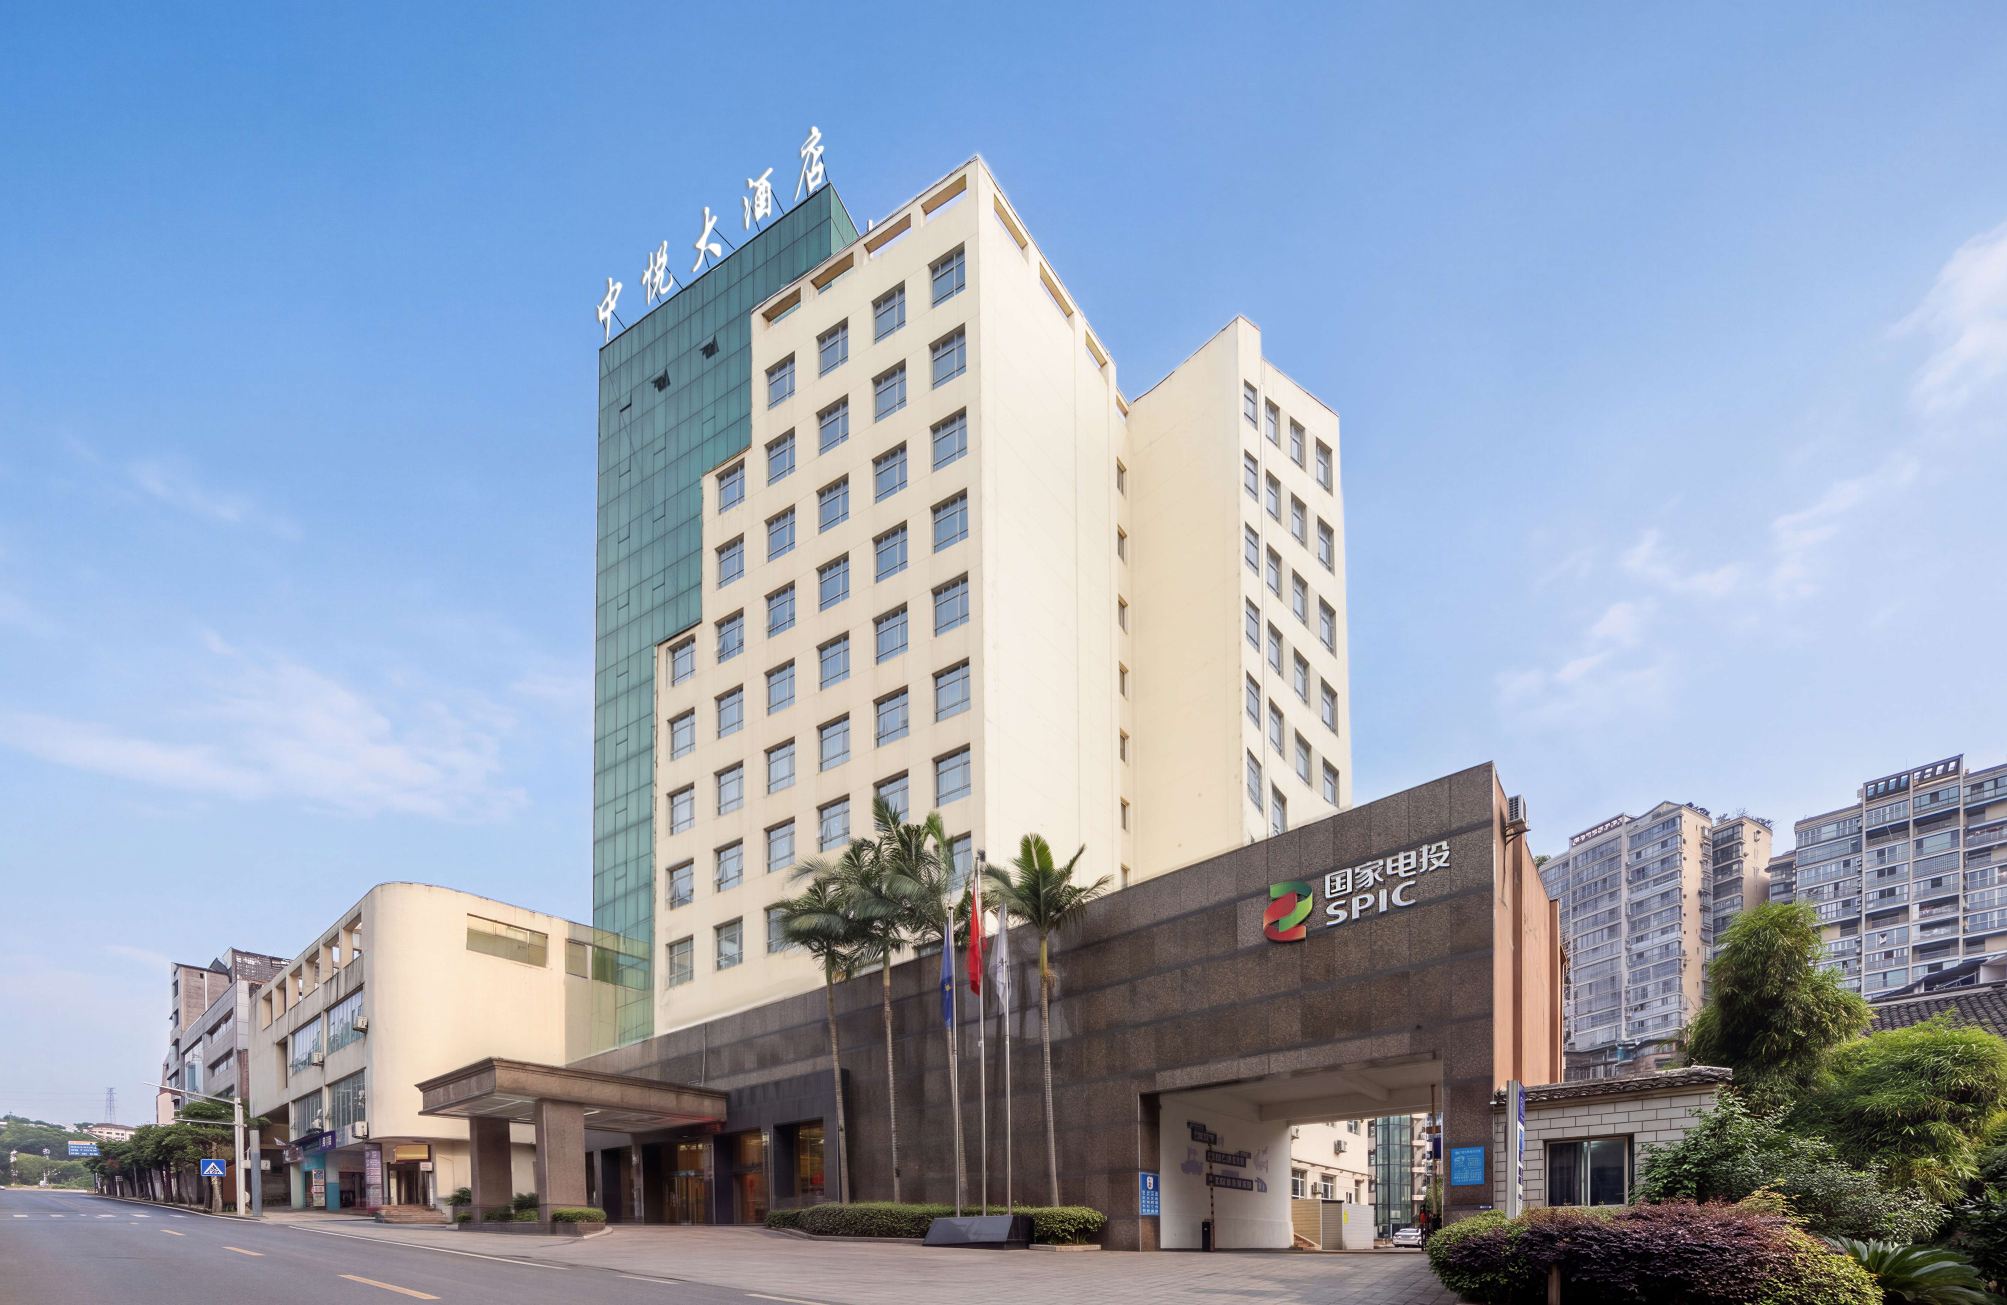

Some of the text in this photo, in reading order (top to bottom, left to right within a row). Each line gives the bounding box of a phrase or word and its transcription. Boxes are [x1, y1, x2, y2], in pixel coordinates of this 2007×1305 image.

[597, 126, 824, 343] 中悦大酒店
[1324, 840, 1450, 899] 国家电投
[1325, 880, 1416, 926] SPIC
